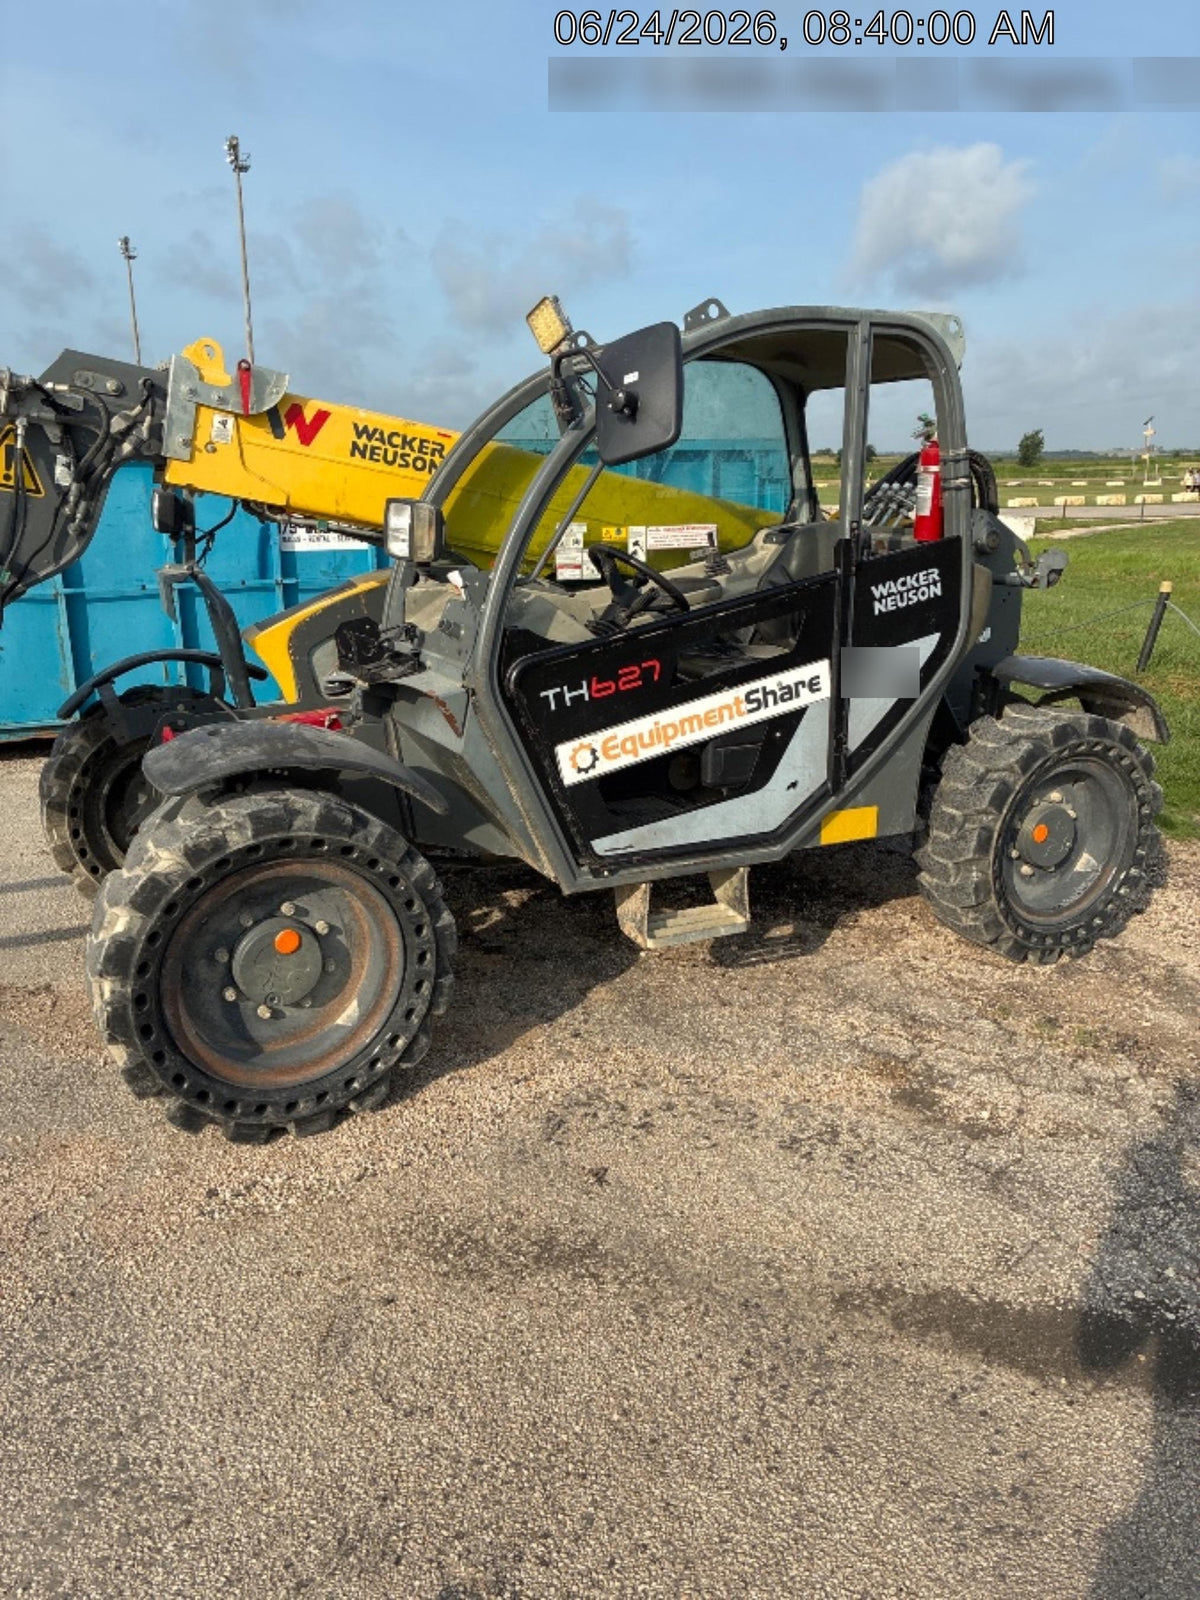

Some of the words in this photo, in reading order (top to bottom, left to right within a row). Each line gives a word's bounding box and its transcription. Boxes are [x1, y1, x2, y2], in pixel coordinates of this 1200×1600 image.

[352, 420, 446, 459] WACKER
[870, 567, 941, 600] WACKER
[873, 582, 942, 616] NEUSON
[540, 658, 661, 711] TH627
[601, 673, 823, 762] EquipmentShare
